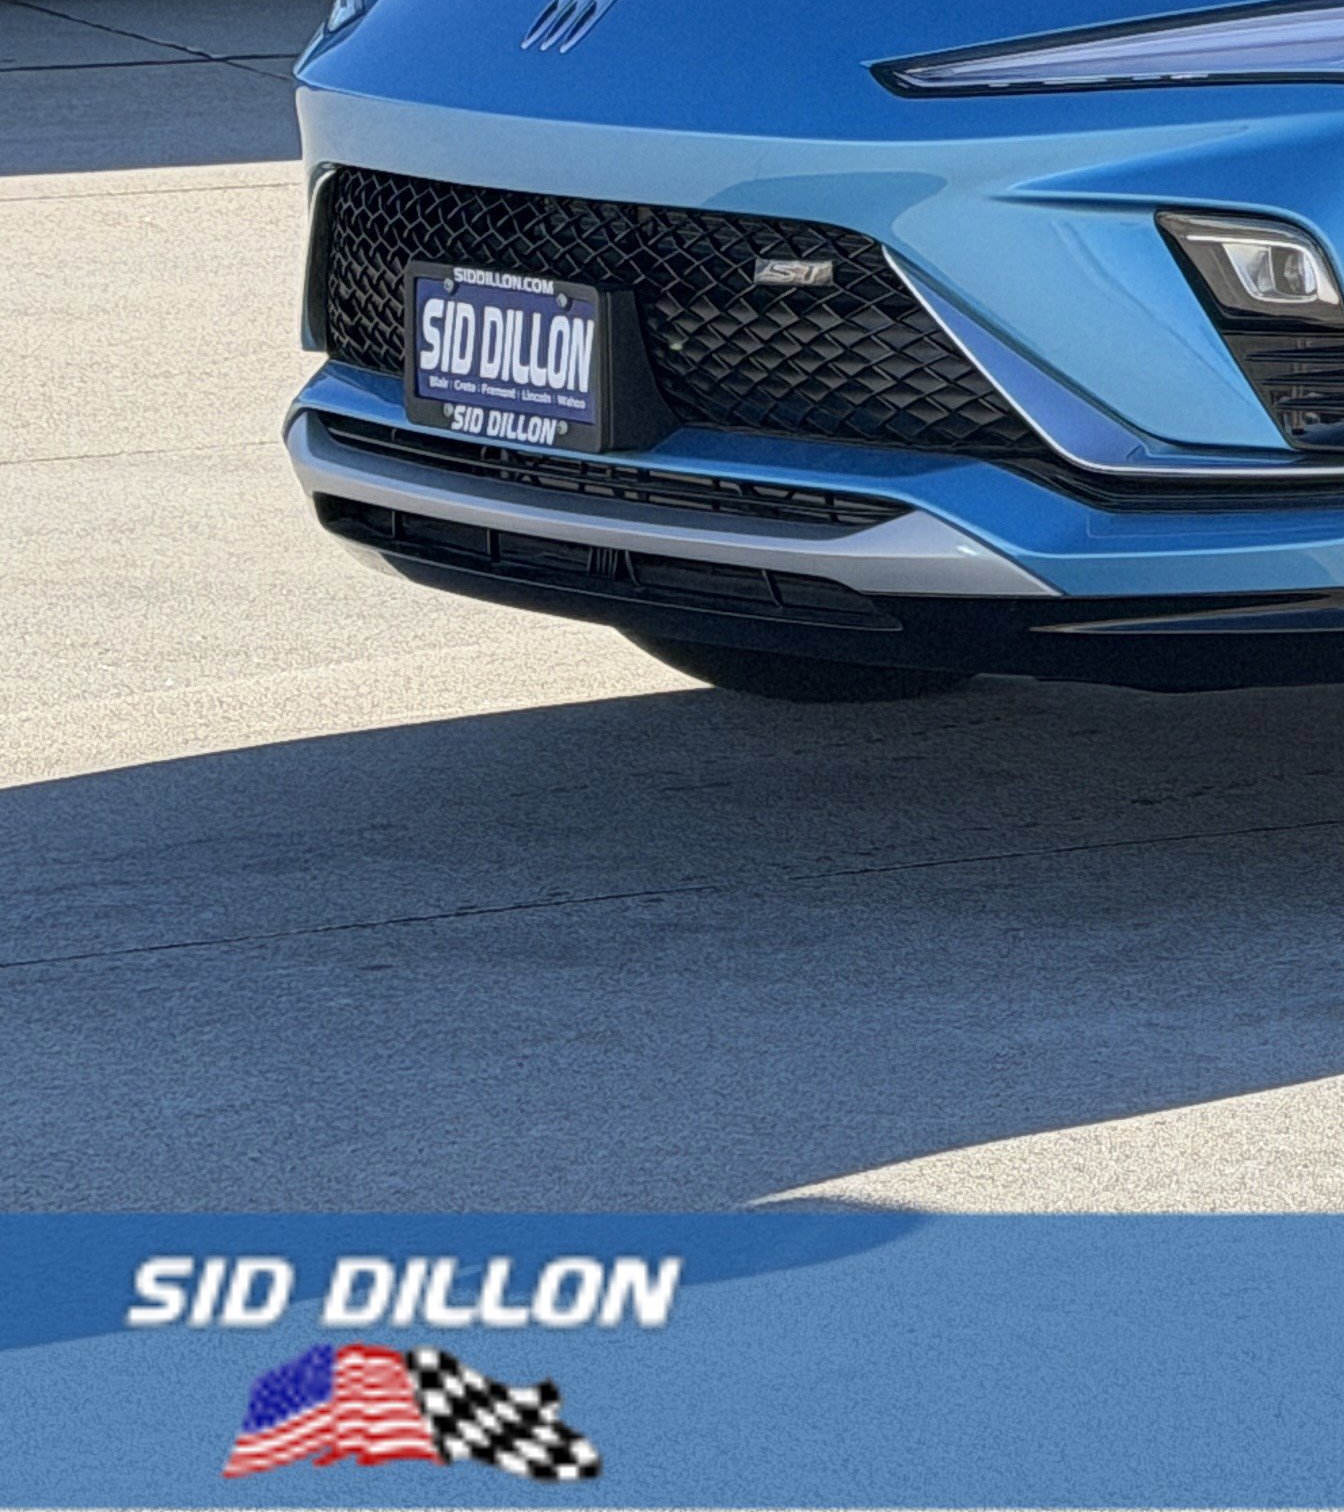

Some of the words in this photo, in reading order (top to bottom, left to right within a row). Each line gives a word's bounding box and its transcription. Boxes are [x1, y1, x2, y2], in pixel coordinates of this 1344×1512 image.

[452, 266, 555, 295] SIDDILLON.COM
[420, 298, 476, 376] SID
[479, 305, 595, 393] DILLON
[451, 404, 484, 434] SID
[486, 410, 557, 446] DILLON
